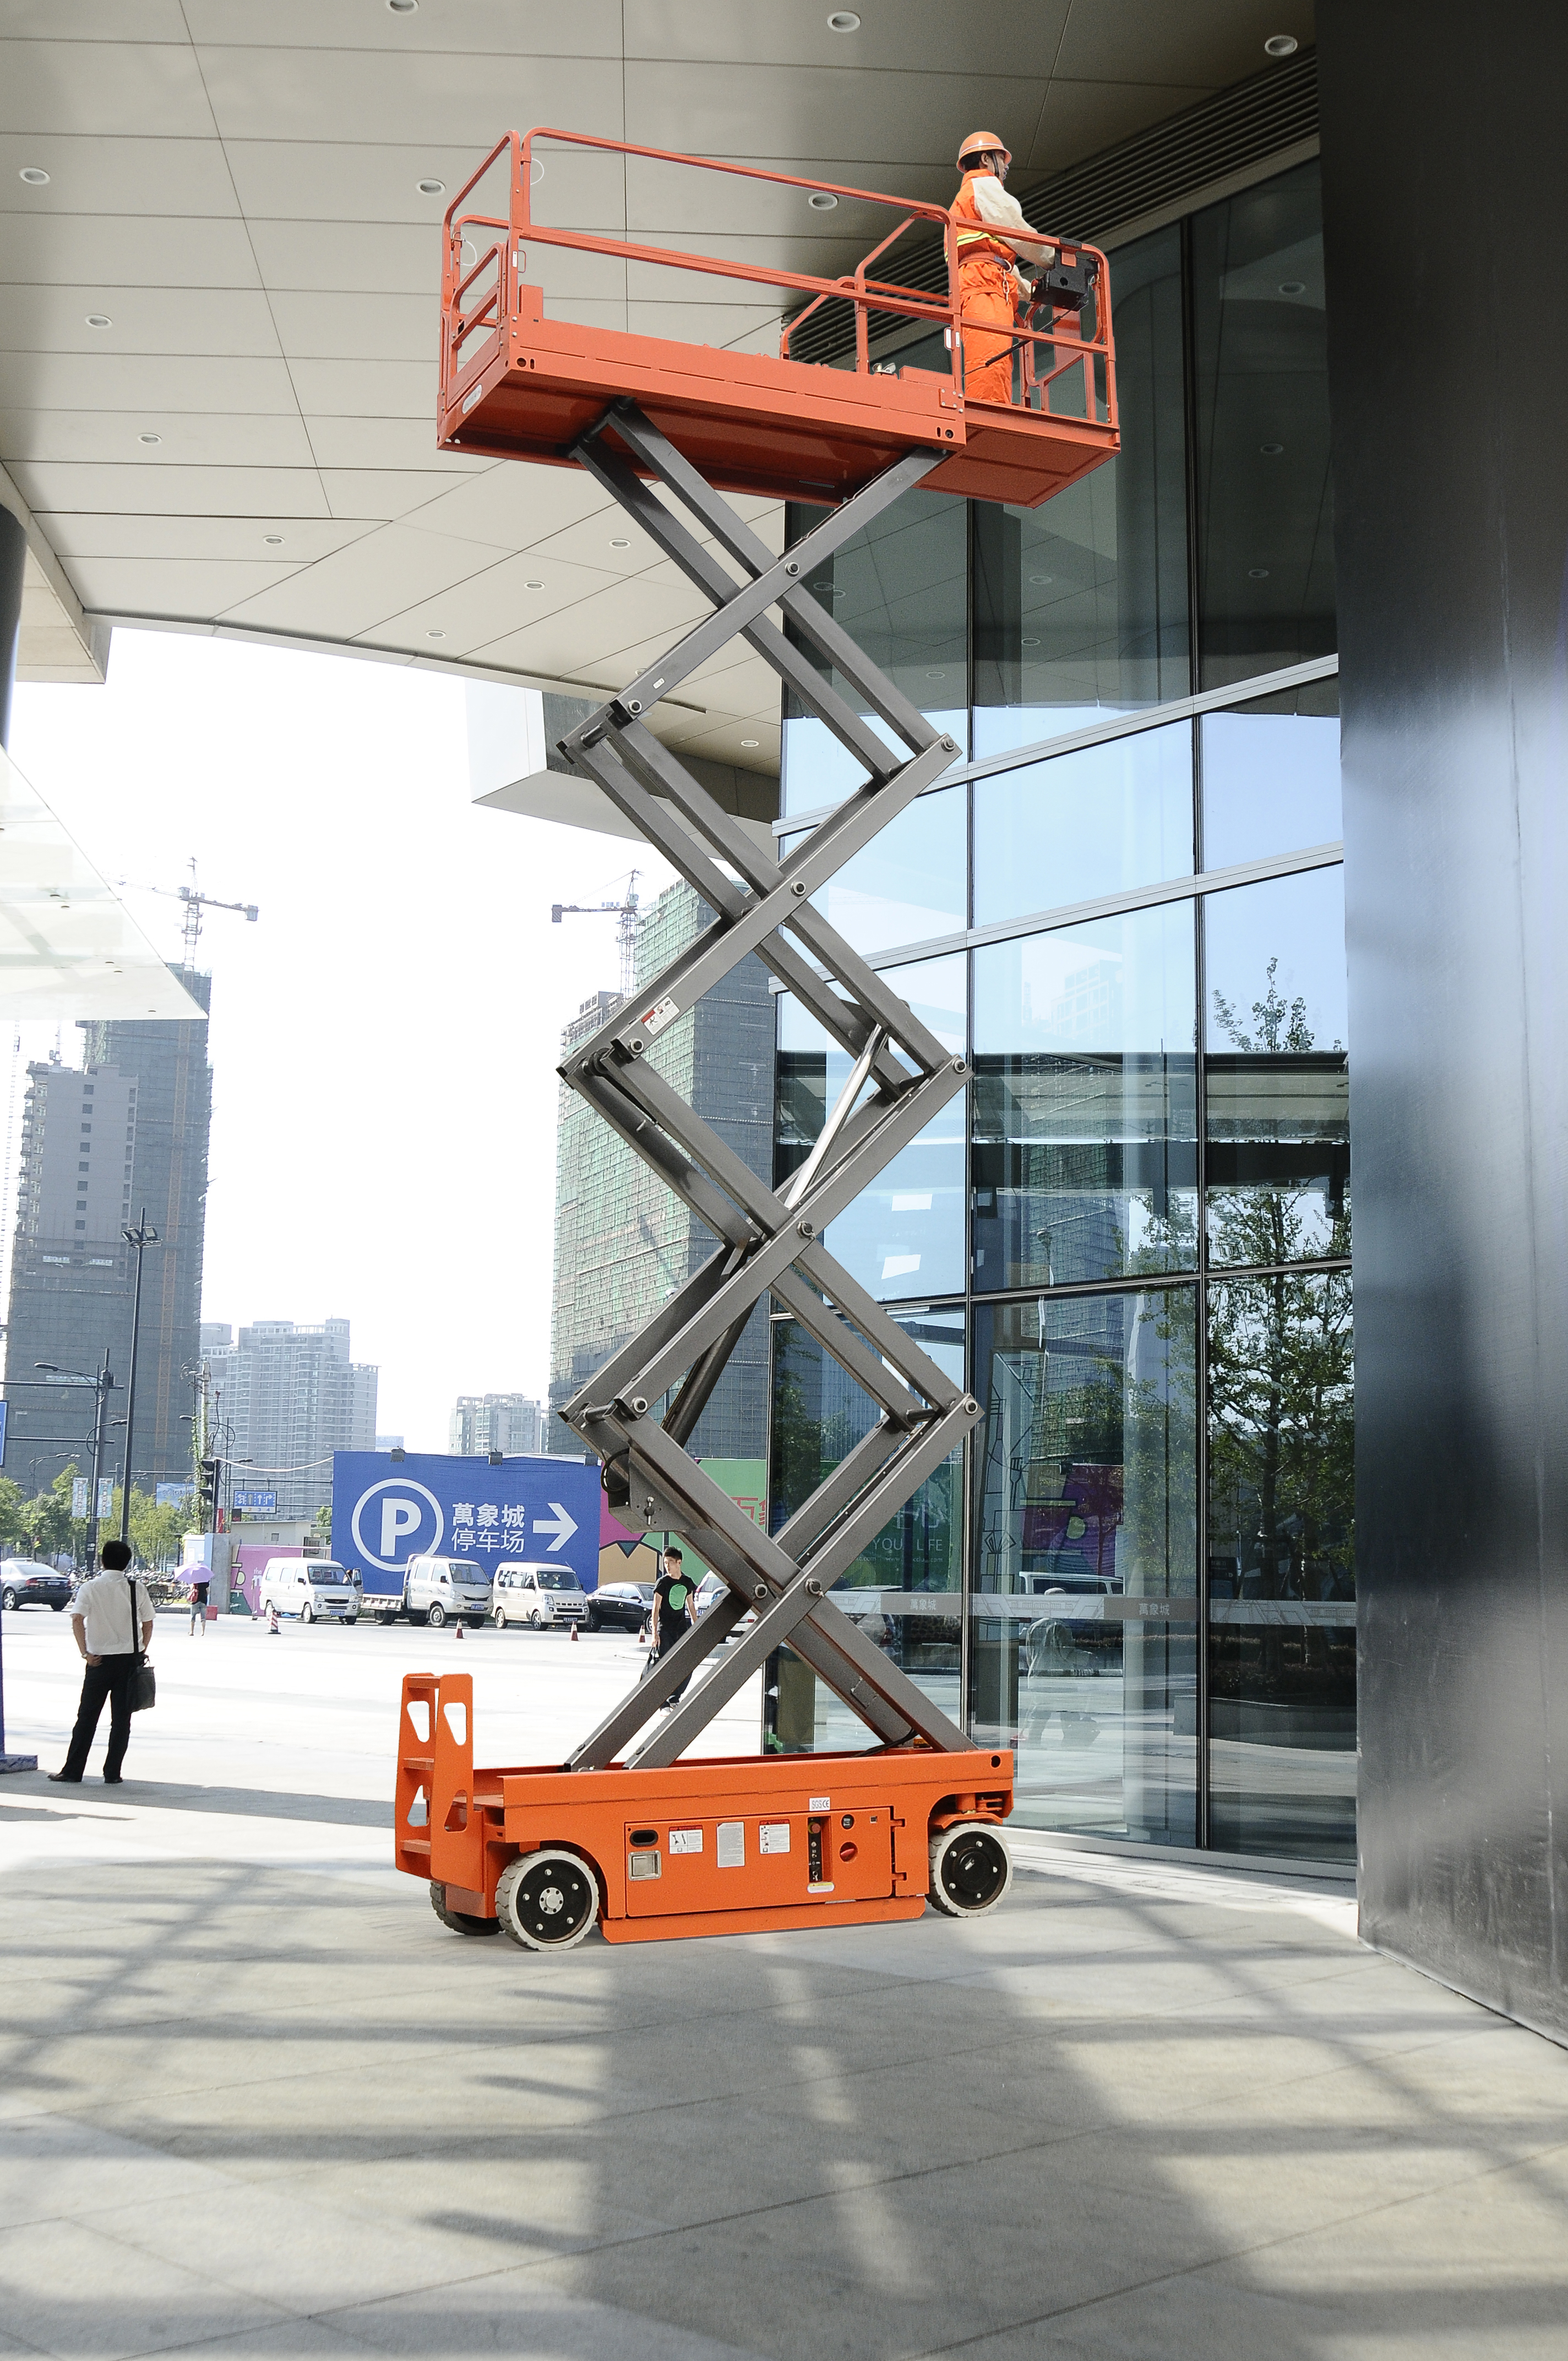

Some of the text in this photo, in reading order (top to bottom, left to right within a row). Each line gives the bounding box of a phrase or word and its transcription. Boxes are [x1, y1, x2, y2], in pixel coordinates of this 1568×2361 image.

[452, 1503, 525, 1528] 萬象城
[380, 1498, 422, 1556] P
[451, 1528, 525, 1553] 停车场
[917, 1539, 943, 1551] LFE
[910, 1598, 936, 1610] 萬象城
[1139, 1603, 1170, 1615] 萬象城
[812, 1800, 822, 1809] SGS
